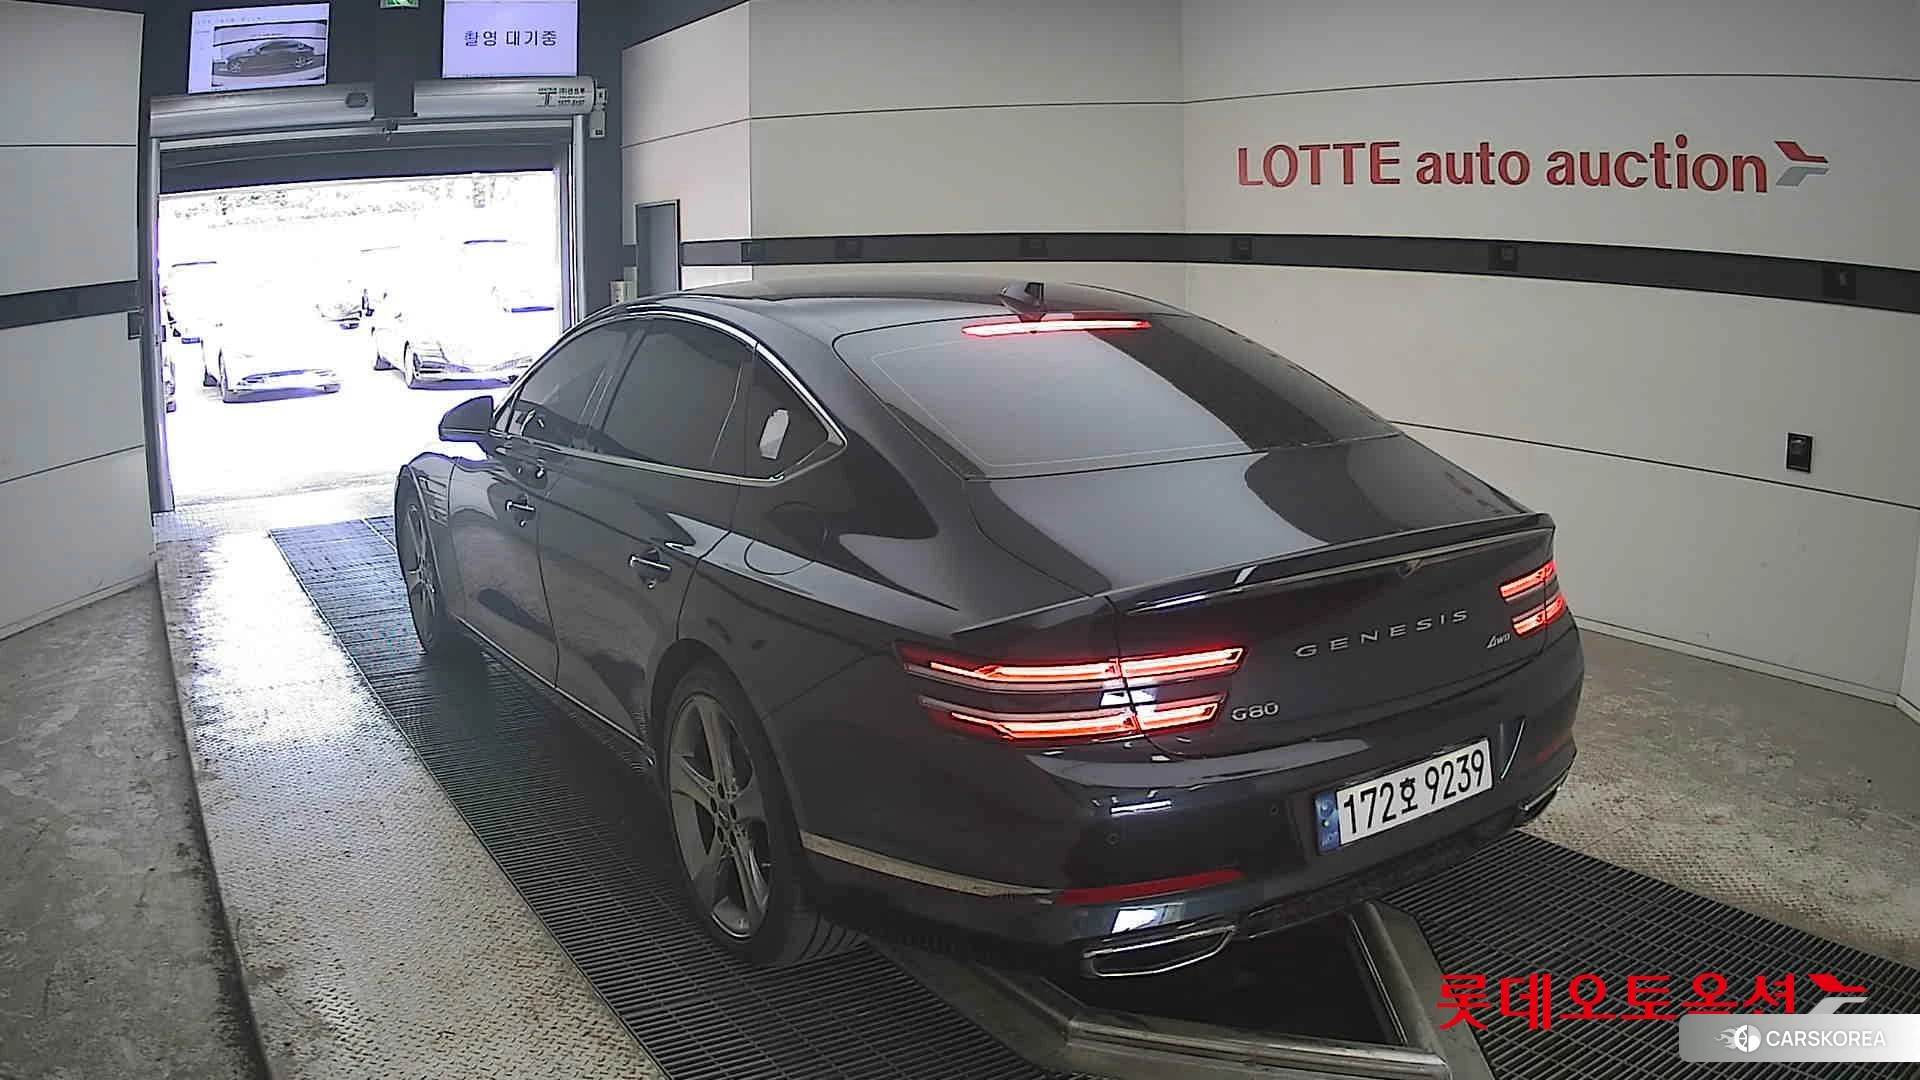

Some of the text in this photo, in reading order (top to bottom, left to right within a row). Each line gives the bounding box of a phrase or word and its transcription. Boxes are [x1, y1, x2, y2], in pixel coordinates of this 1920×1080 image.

[505, 30, 557, 47] 대기중
[1238, 134, 1768, 193] LOTTE auto auction
[1295, 609, 1468, 658] GENESIS
[1231, 702, 1280, 722] G80
[1343, 749, 1485, 835] 172호 9239
